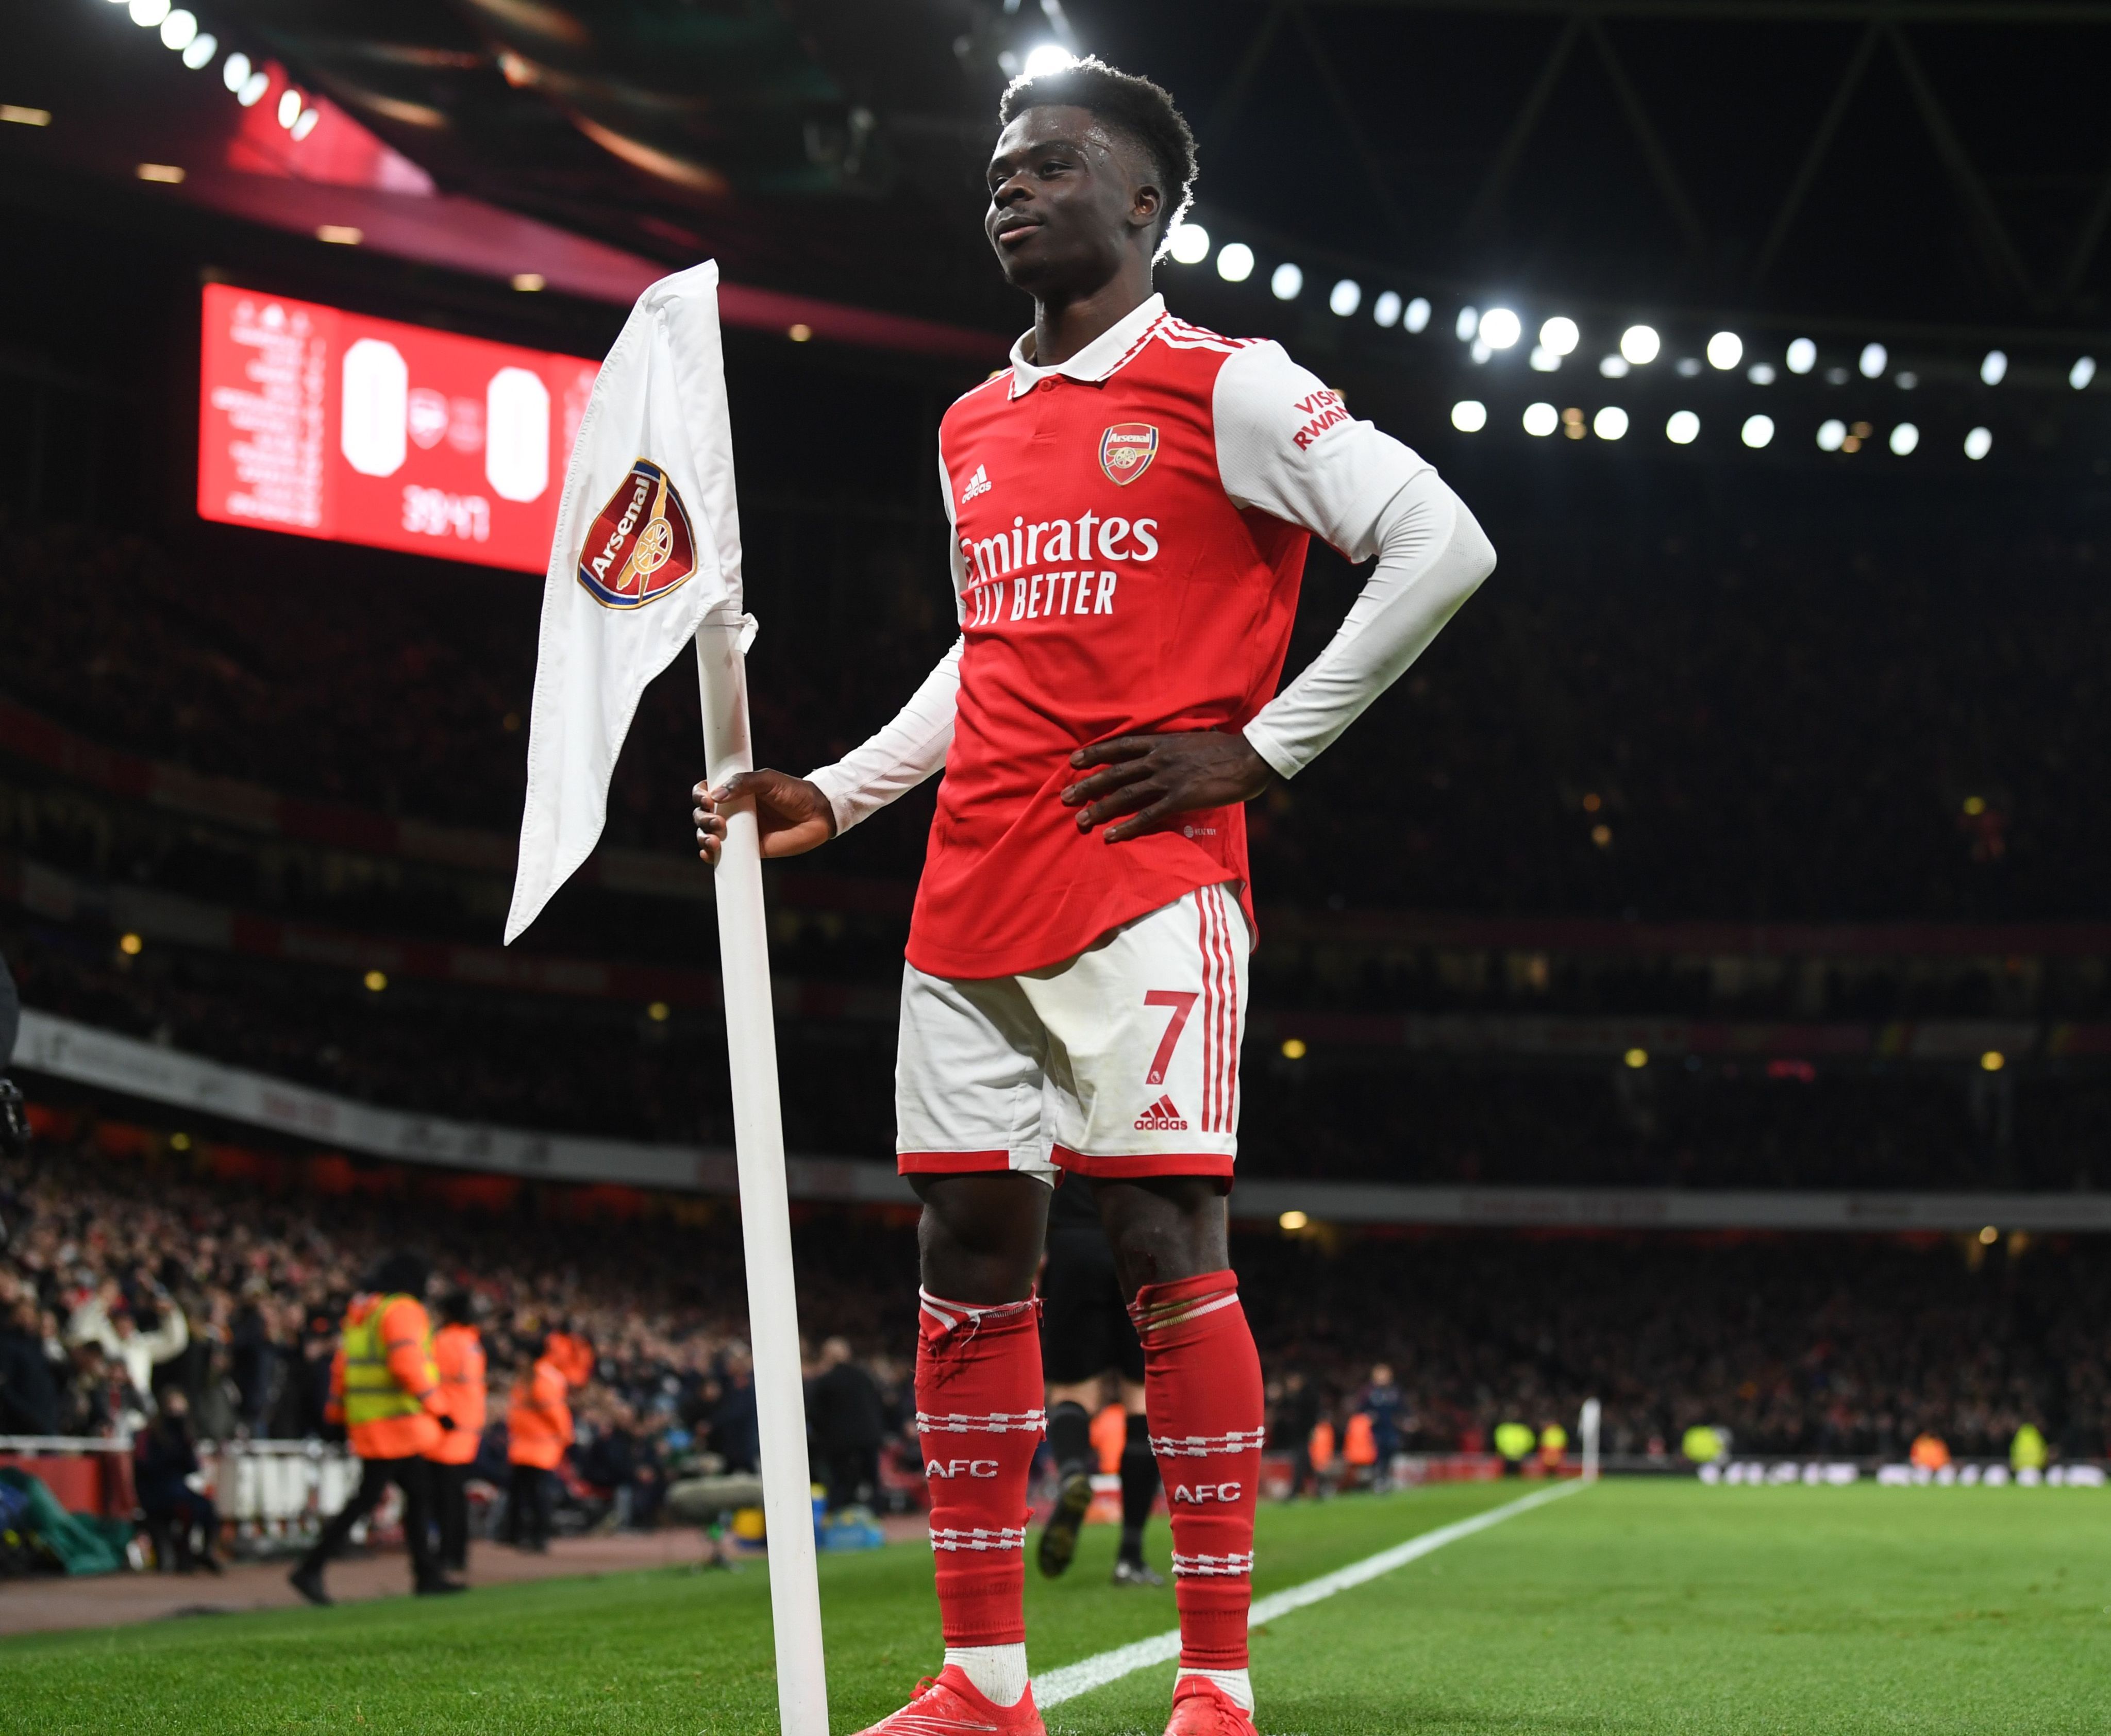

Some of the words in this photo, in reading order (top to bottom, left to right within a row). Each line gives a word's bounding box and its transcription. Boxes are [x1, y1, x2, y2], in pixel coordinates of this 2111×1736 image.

[341, 337, 408, 478] 0
[485, 366, 550, 503] 0
[1108, 433, 1150, 443] Arsenal
[961, 480, 992, 504] adidas
[592, 476, 650, 581] Arsenal
[969, 581, 1004, 628] FLY
[1010, 571, 1117, 622] BETTER
[1144, 990, 1200, 1085] 7
[1134, 1117, 1188, 1130] adidas
[926, 1459, 999, 1479] AFC
[1175, 1482, 1242, 1504] AFC
